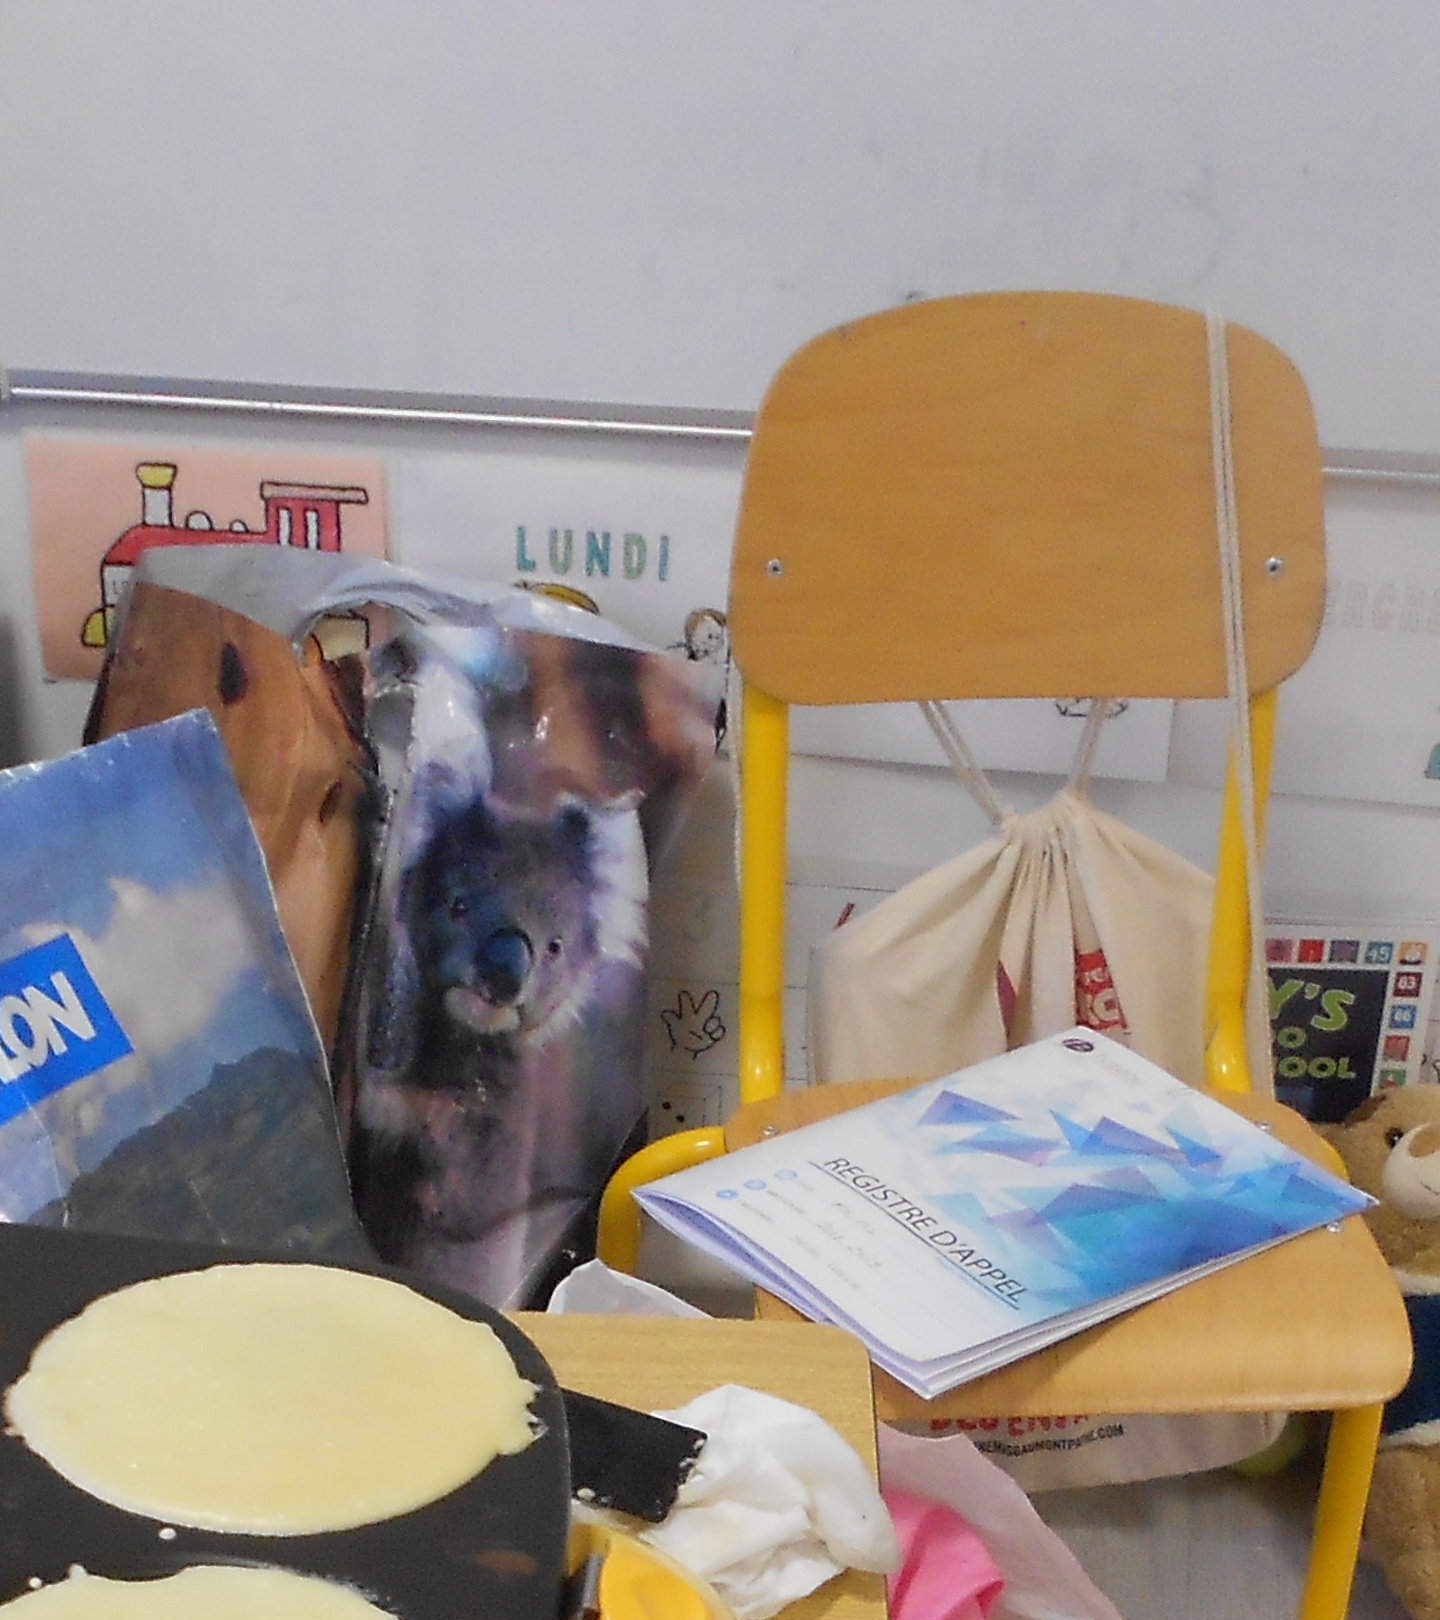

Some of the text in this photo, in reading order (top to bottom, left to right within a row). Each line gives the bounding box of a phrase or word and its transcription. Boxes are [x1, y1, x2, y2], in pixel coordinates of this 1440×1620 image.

[517, 525, 669, 581] LUNDI
[823, 1157, 939, 1232] REGISTRE
[928, 1229, 1029, 1305] D'APPEL
